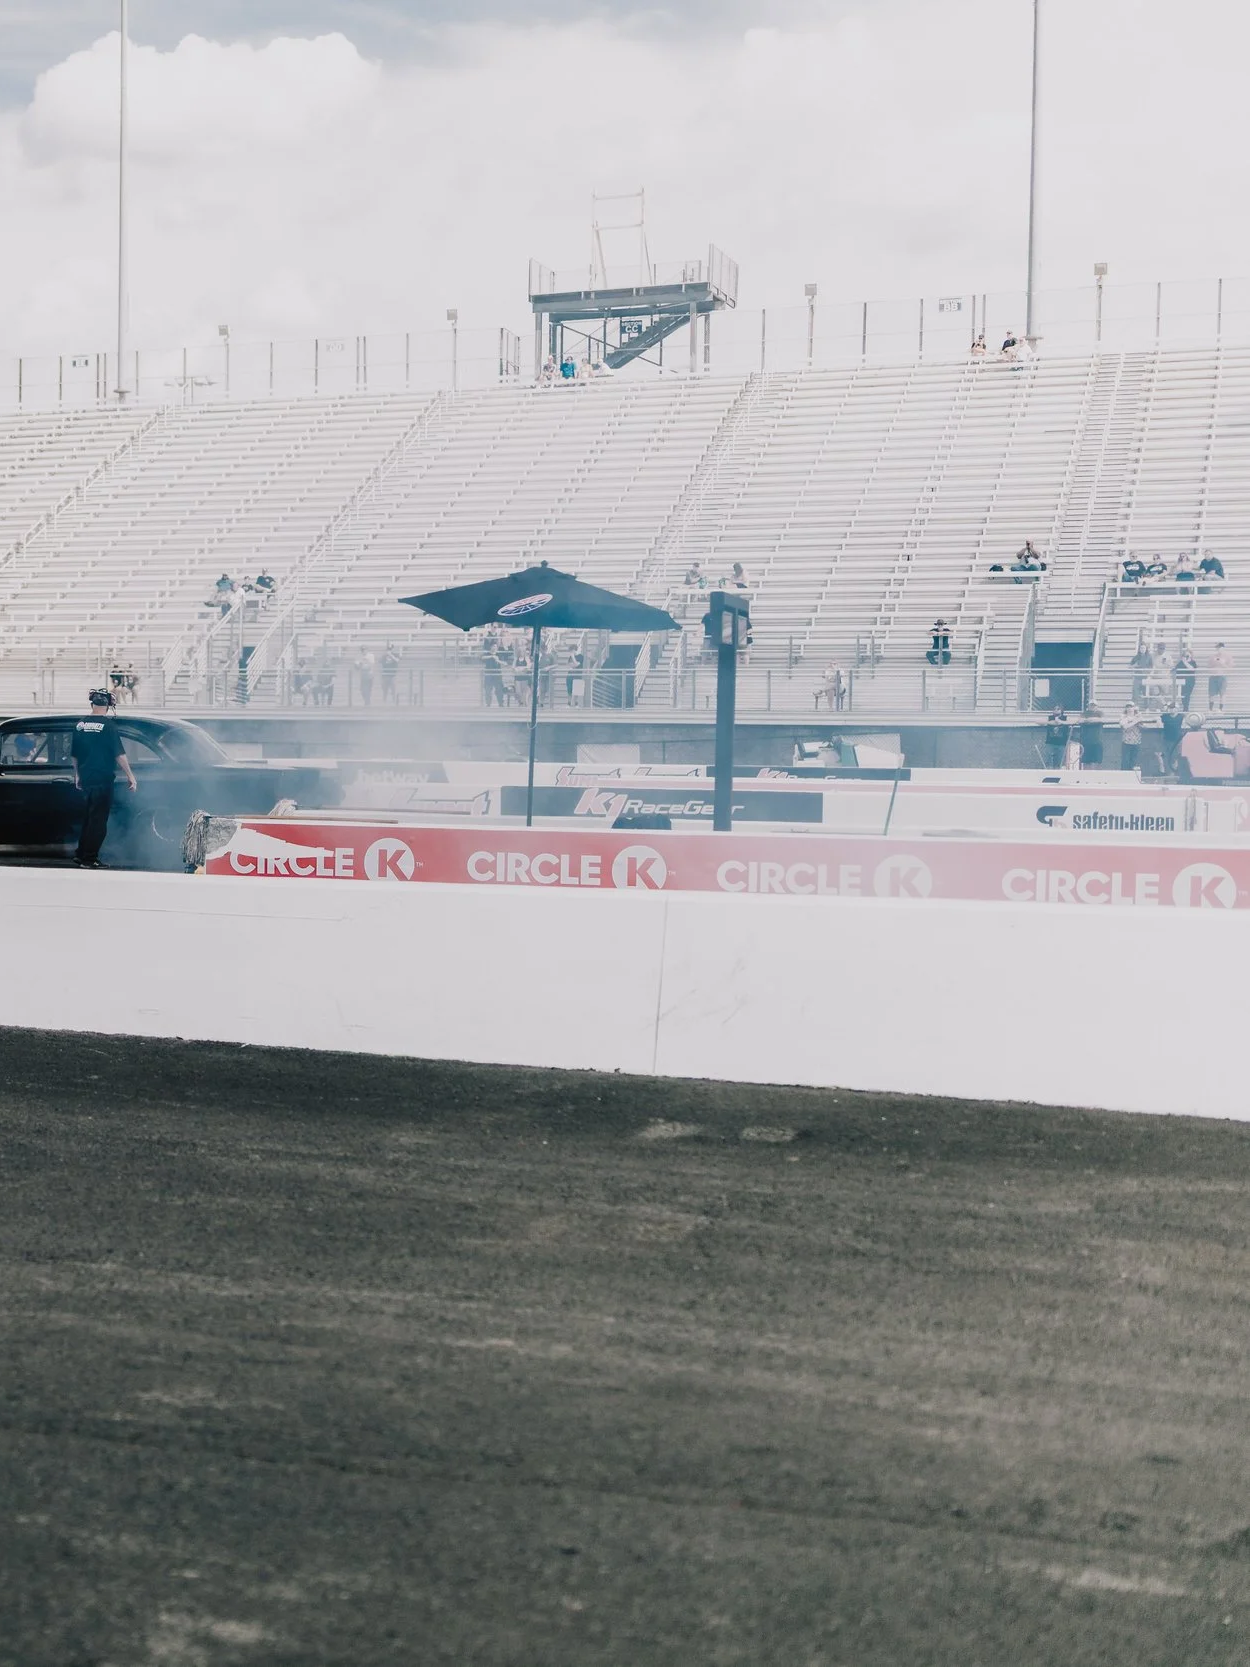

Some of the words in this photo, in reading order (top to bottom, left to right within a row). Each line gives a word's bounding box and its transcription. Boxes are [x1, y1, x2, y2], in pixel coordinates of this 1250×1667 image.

[625, 325, 639, 333] CC
[622, 799, 745, 815] RaceGer
[229, 848, 354, 878] CIRCLE
[377, 848, 410, 881] K
[467, 851, 601, 885] CIRCLE
[626, 856, 660, 889] K
[716, 860, 861, 896] CIRCLE
[888, 866, 924, 897] K
[1001, 868, 1161, 905] CIRCLE
[1189, 874, 1232, 908] K
